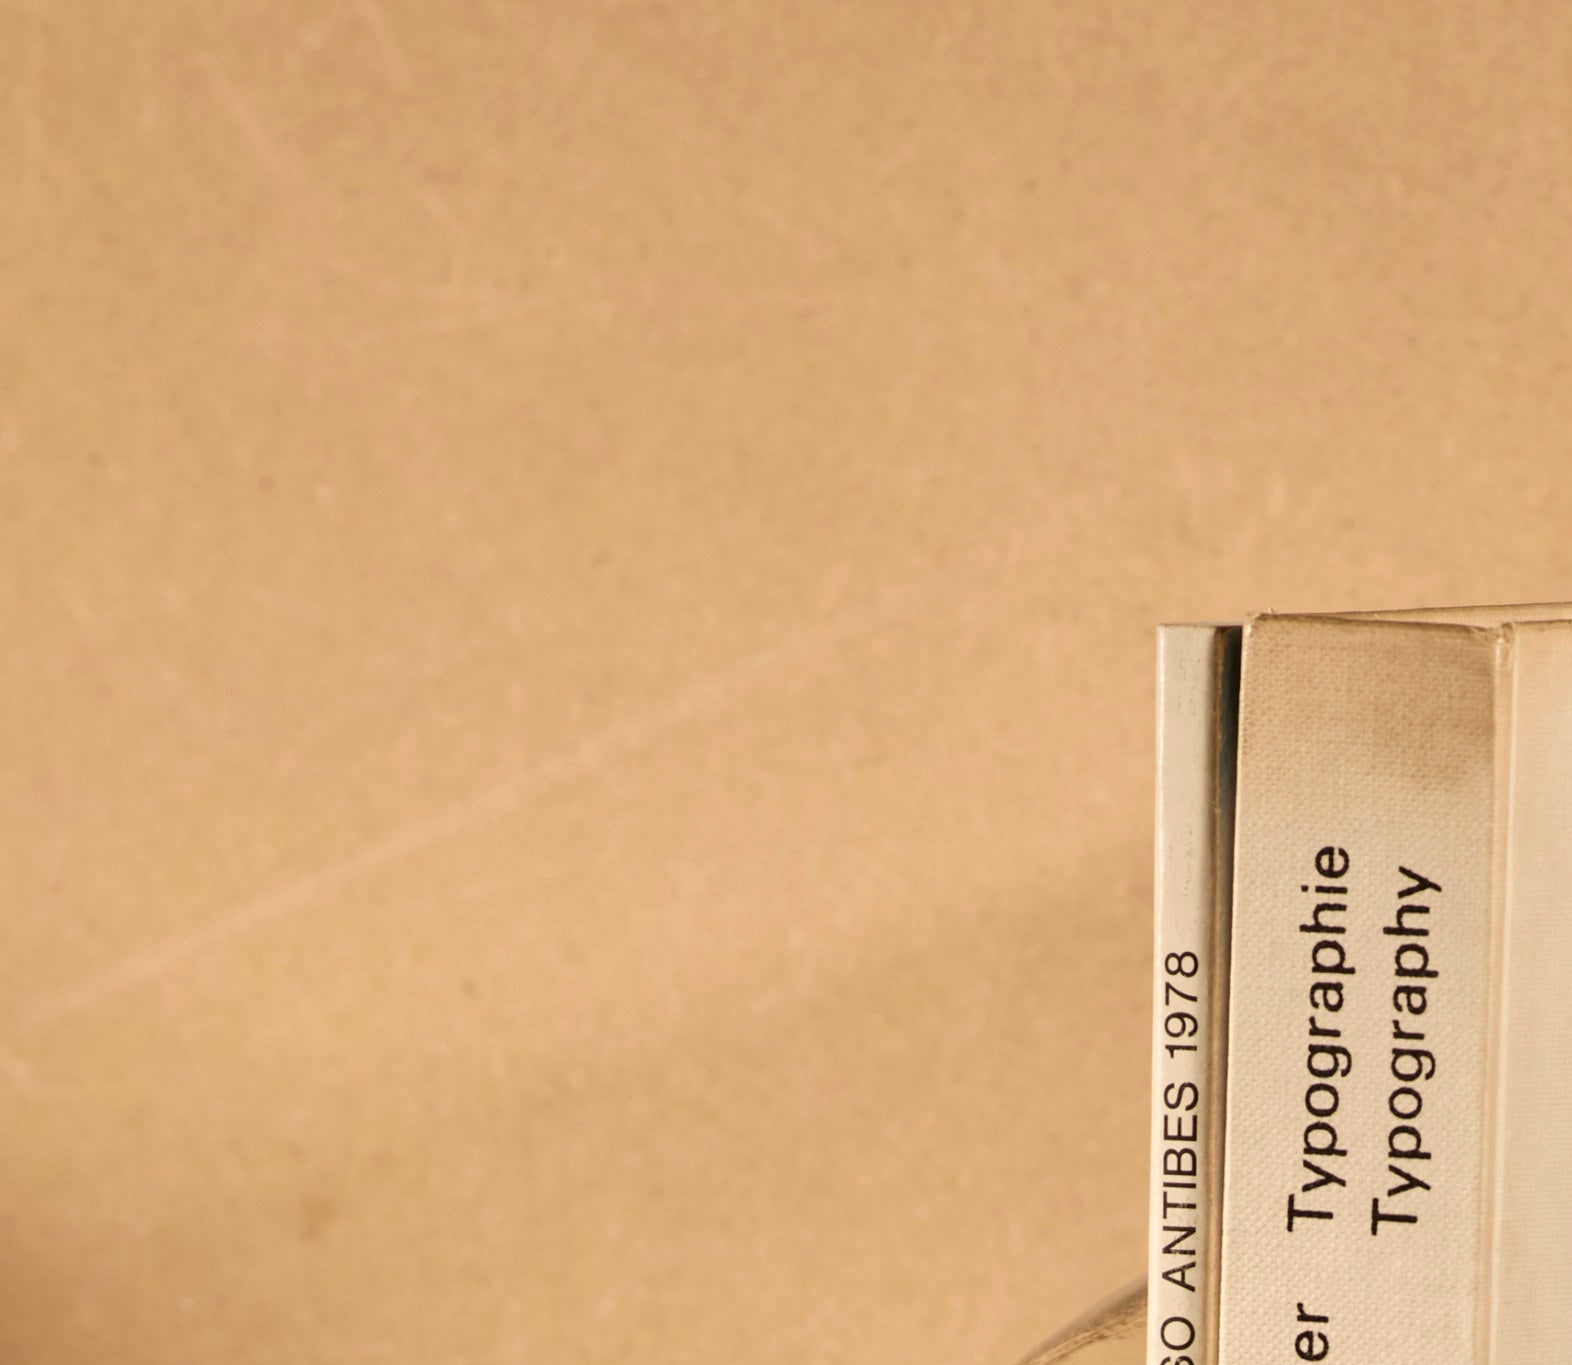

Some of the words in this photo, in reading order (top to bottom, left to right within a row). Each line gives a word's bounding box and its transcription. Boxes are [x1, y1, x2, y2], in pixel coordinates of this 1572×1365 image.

[1164, 951, 1199, 1060] 1978
[1287, 845, 1356, 1233] Typographie
[1371, 865, 1442, 1236] Typography
[1162, 1081, 1199, 1293] ANTIBES
